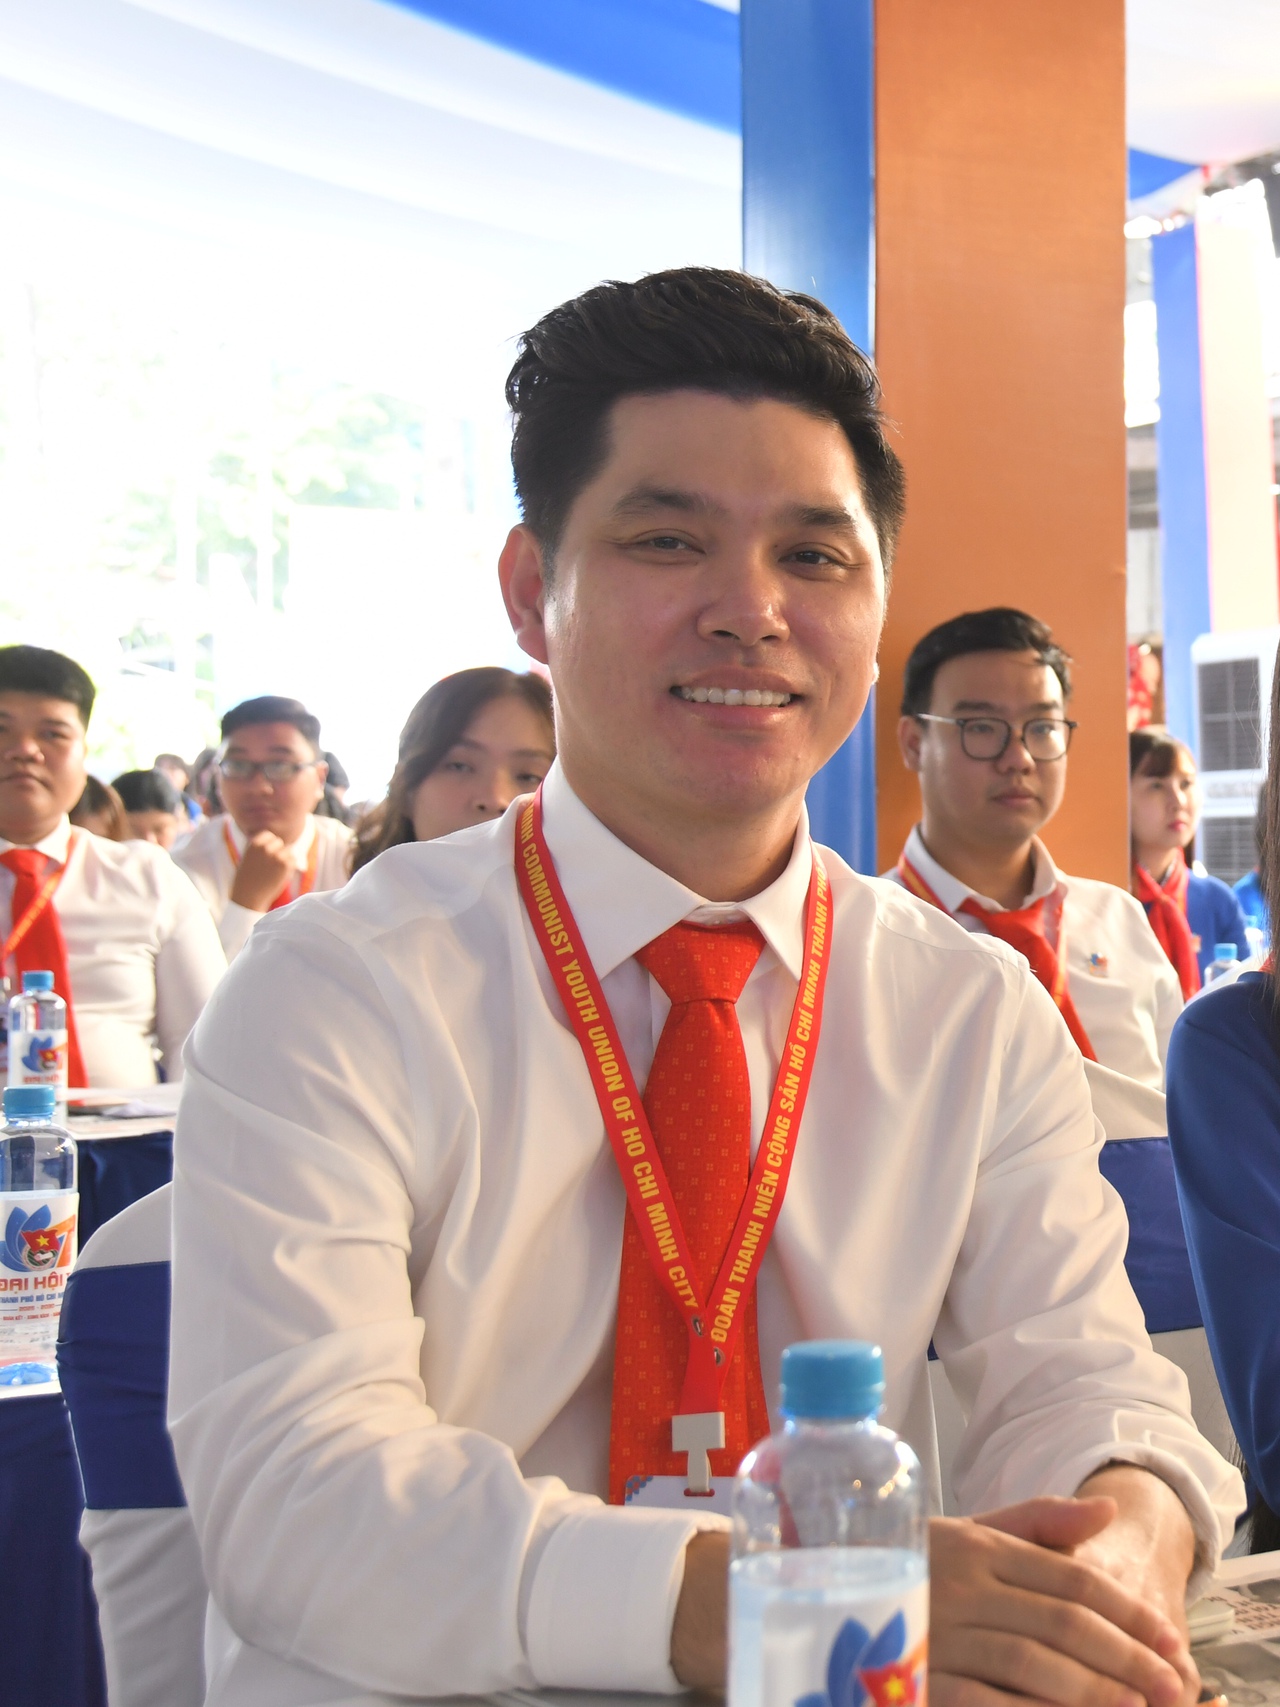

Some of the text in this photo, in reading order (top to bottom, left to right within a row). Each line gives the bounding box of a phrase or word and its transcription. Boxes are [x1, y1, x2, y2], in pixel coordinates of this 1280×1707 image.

[523, 842, 574, 955] COMMUNIST
[811, 901, 828, 958] THÀNH
[562, 958, 600, 1023] YOUTH
[802, 959, 821, 1009] MINH
[796, 1007, 814, 1042] CHÍ
[588, 1025, 625, 1093] UNION
[612, 1096, 636, 1121] OF
[778, 1072, 801, 1113] SẢN
[621, 1126, 646, 1158] HO
[766, 1115, 791, 1168] CỘNG
[633, 1161, 660, 1200] CHI
[752, 1169, 779, 1219] NIÊN
[646, 1201, 680, 1263] MINH
[729, 1221, 765, 1283] THANH
[0, 1271, 63, 1294] ĐẠI HỘI
[668, 1265, 699, 1309] CITY
[710, 1287, 741, 1343] ĐOÀN
